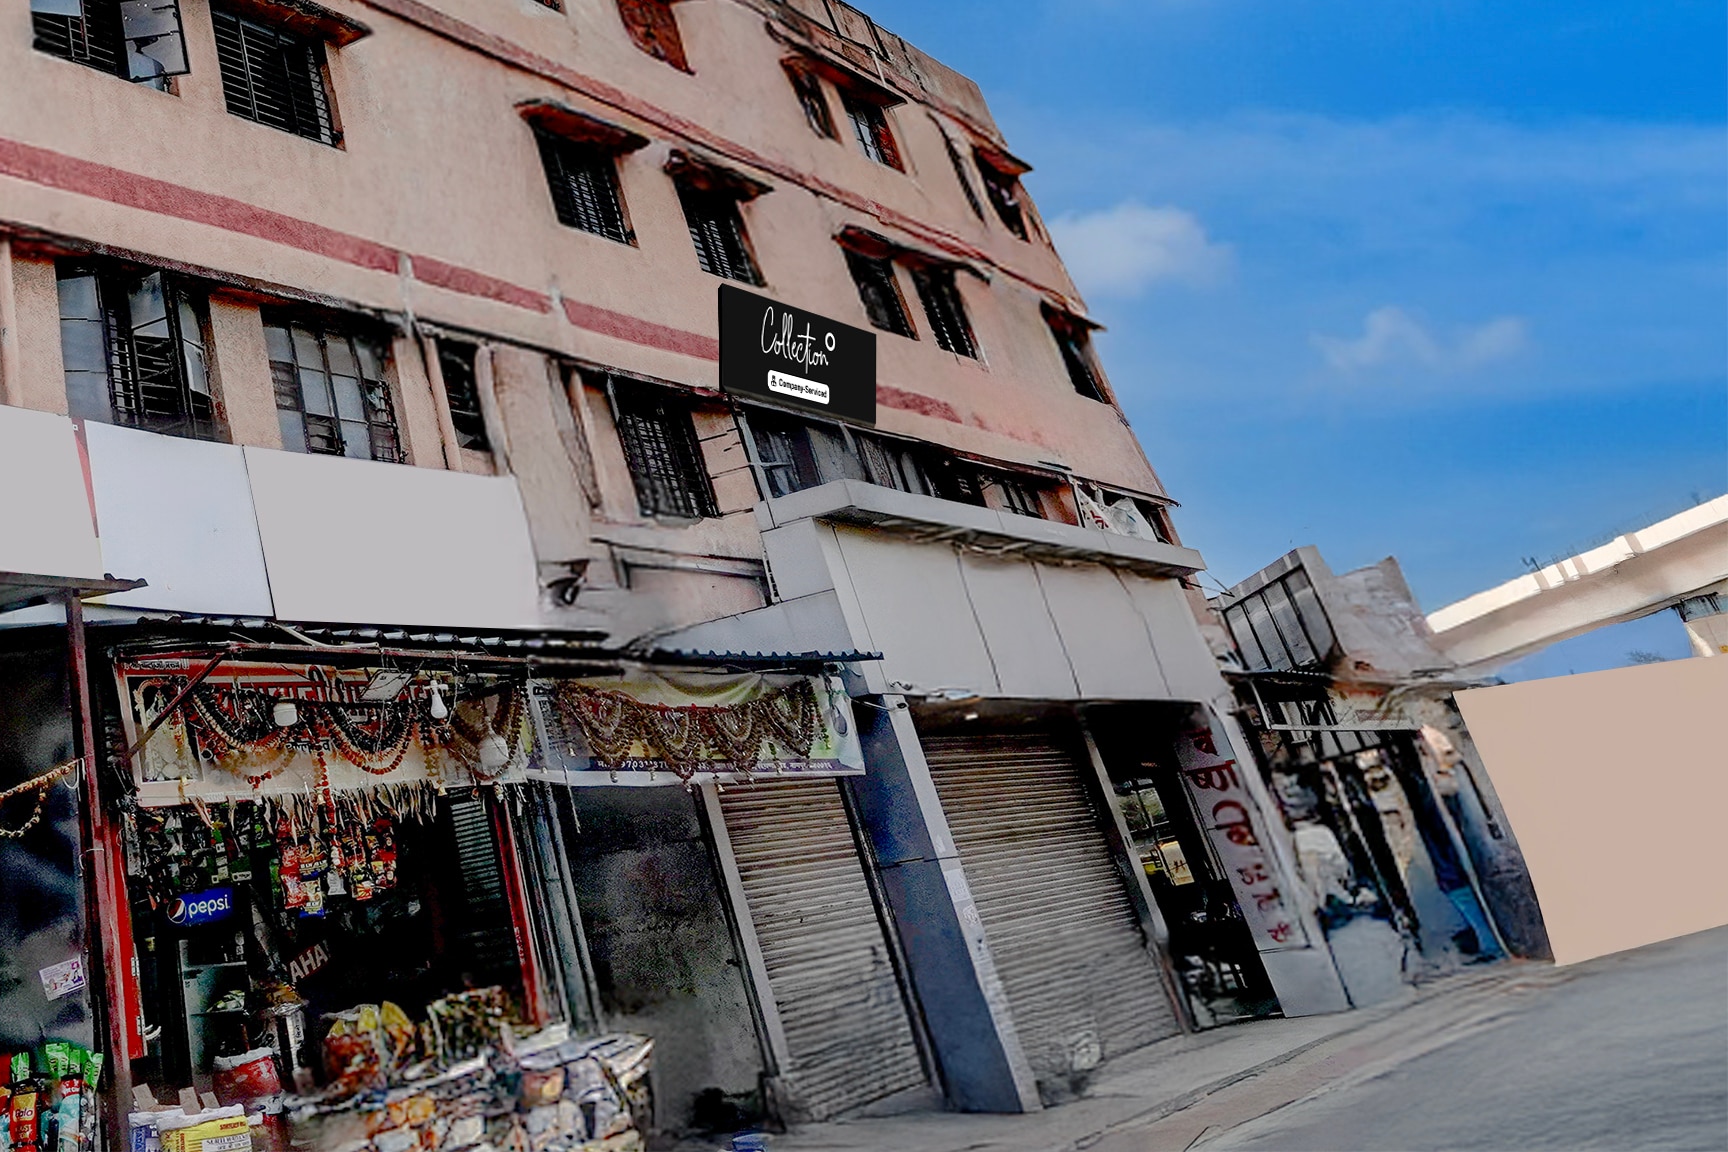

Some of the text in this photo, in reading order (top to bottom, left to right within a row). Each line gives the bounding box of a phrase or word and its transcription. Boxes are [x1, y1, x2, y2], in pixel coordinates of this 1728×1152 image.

[761, 306, 828, 374] Collection
[778, 378, 827, 398] Company-Serviced
[188, 894, 228, 919] pepsi
